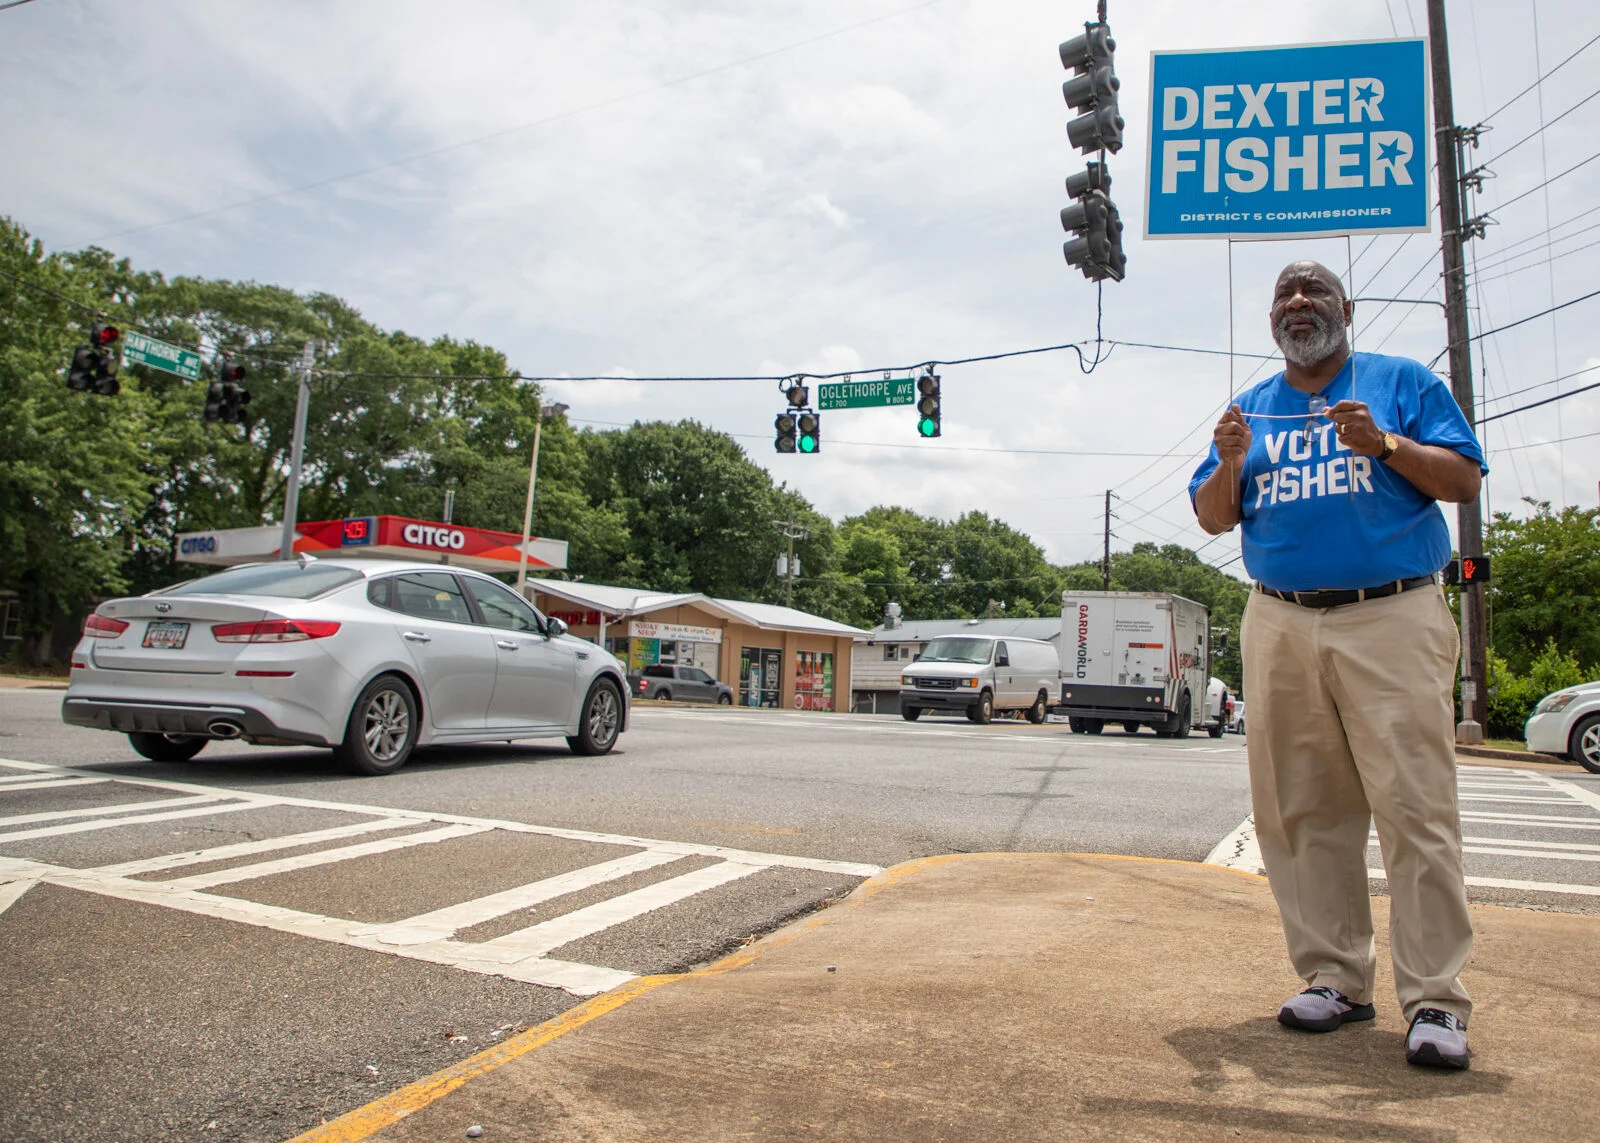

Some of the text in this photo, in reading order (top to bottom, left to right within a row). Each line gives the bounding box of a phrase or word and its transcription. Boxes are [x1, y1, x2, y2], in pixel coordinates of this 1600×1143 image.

[1162, 77, 1385, 131] DEXTER
[1161, 130, 1414, 194] FISHER
[1180, 207, 1392, 222] DISTRICT 5 COMMISSIONER
[820, 382, 913, 398] OGLETHORPE AVE
[835, 399, 847, 407] 700
[1255, 456, 1374, 509] FISHER
[180, 536, 216, 554] CITGO
[403, 524, 465, 549] CITGO
[635, 623, 659, 631] SMOKE
[638, 629, 657, 637] SHOP
